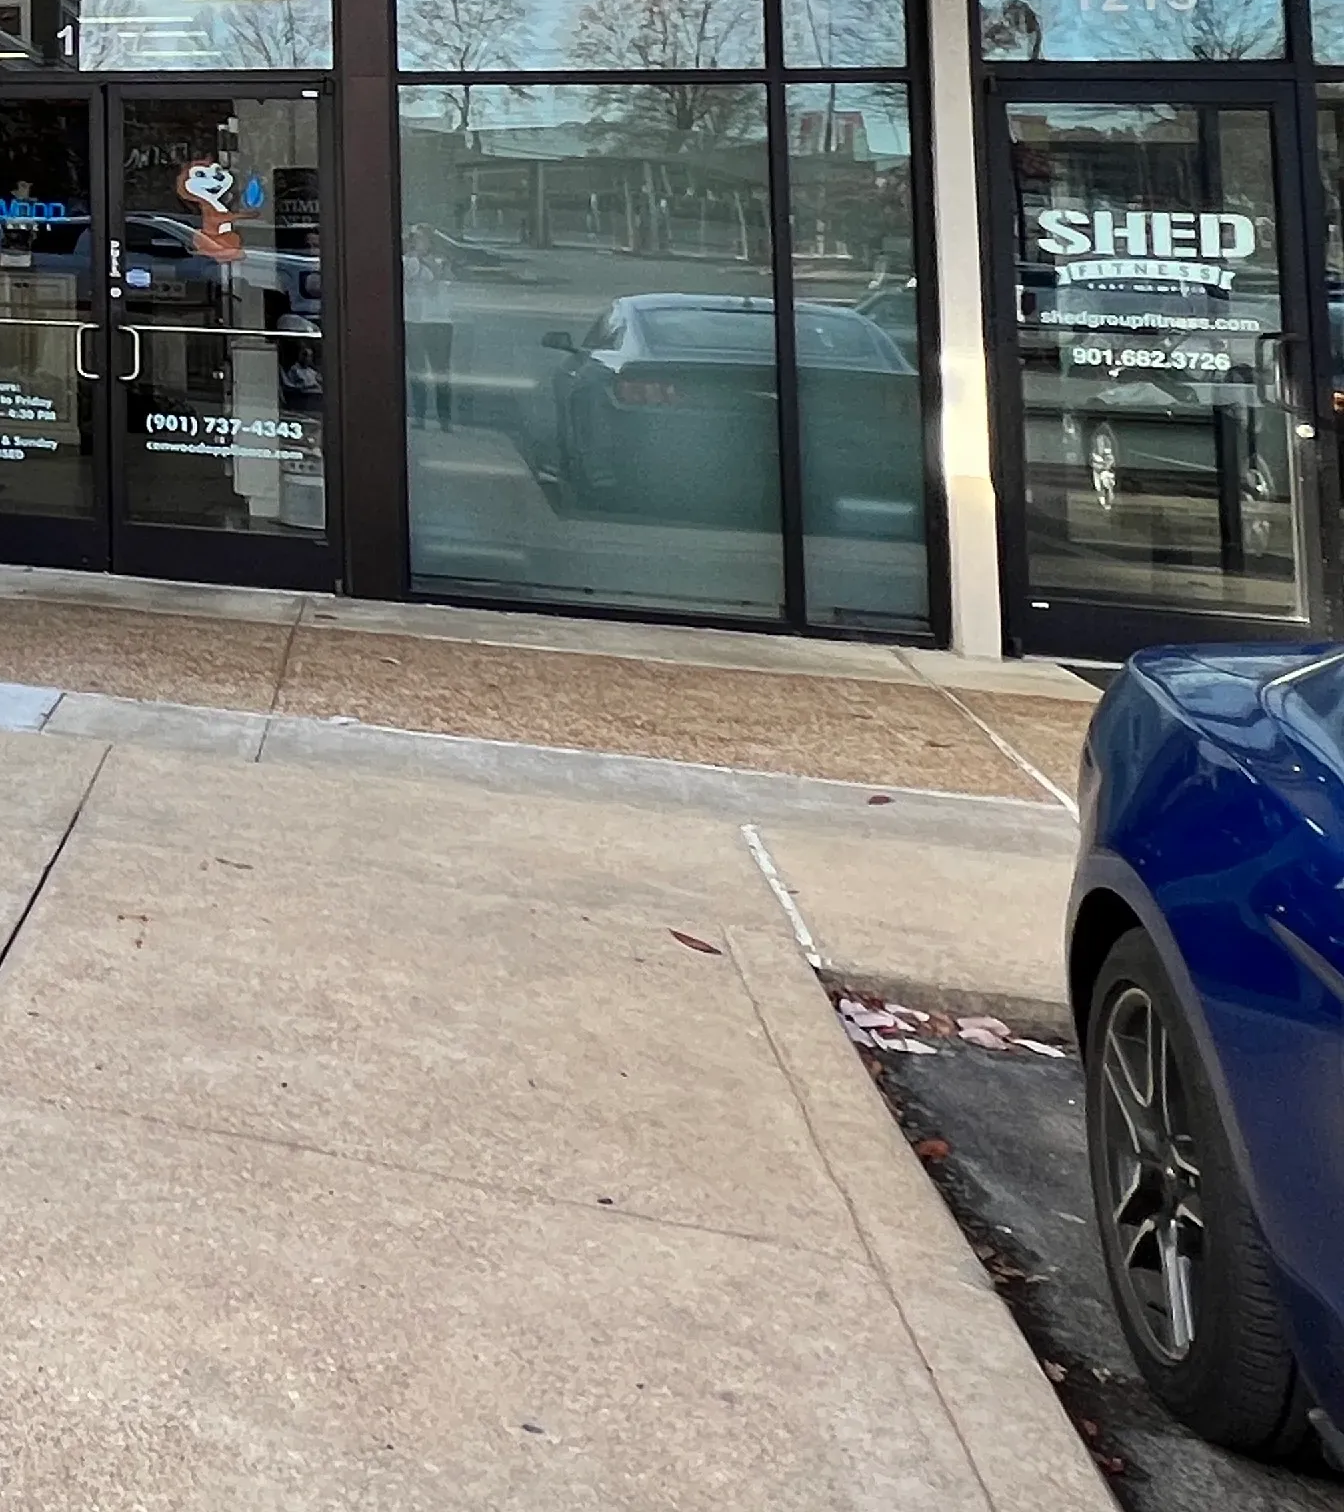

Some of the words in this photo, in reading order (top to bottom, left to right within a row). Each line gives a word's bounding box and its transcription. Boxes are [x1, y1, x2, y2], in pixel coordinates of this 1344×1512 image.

[1037, 209, 1256, 258] SHED
[1078, 264, 1211, 282] FITNESS
[1040, 310, 1260, 332] shedgroupfitness.com
[1072, 347, 1232, 371] 901.682.3726
[146, 413, 198, 436] (901)
[203, 416, 303, 440] 737-4343
